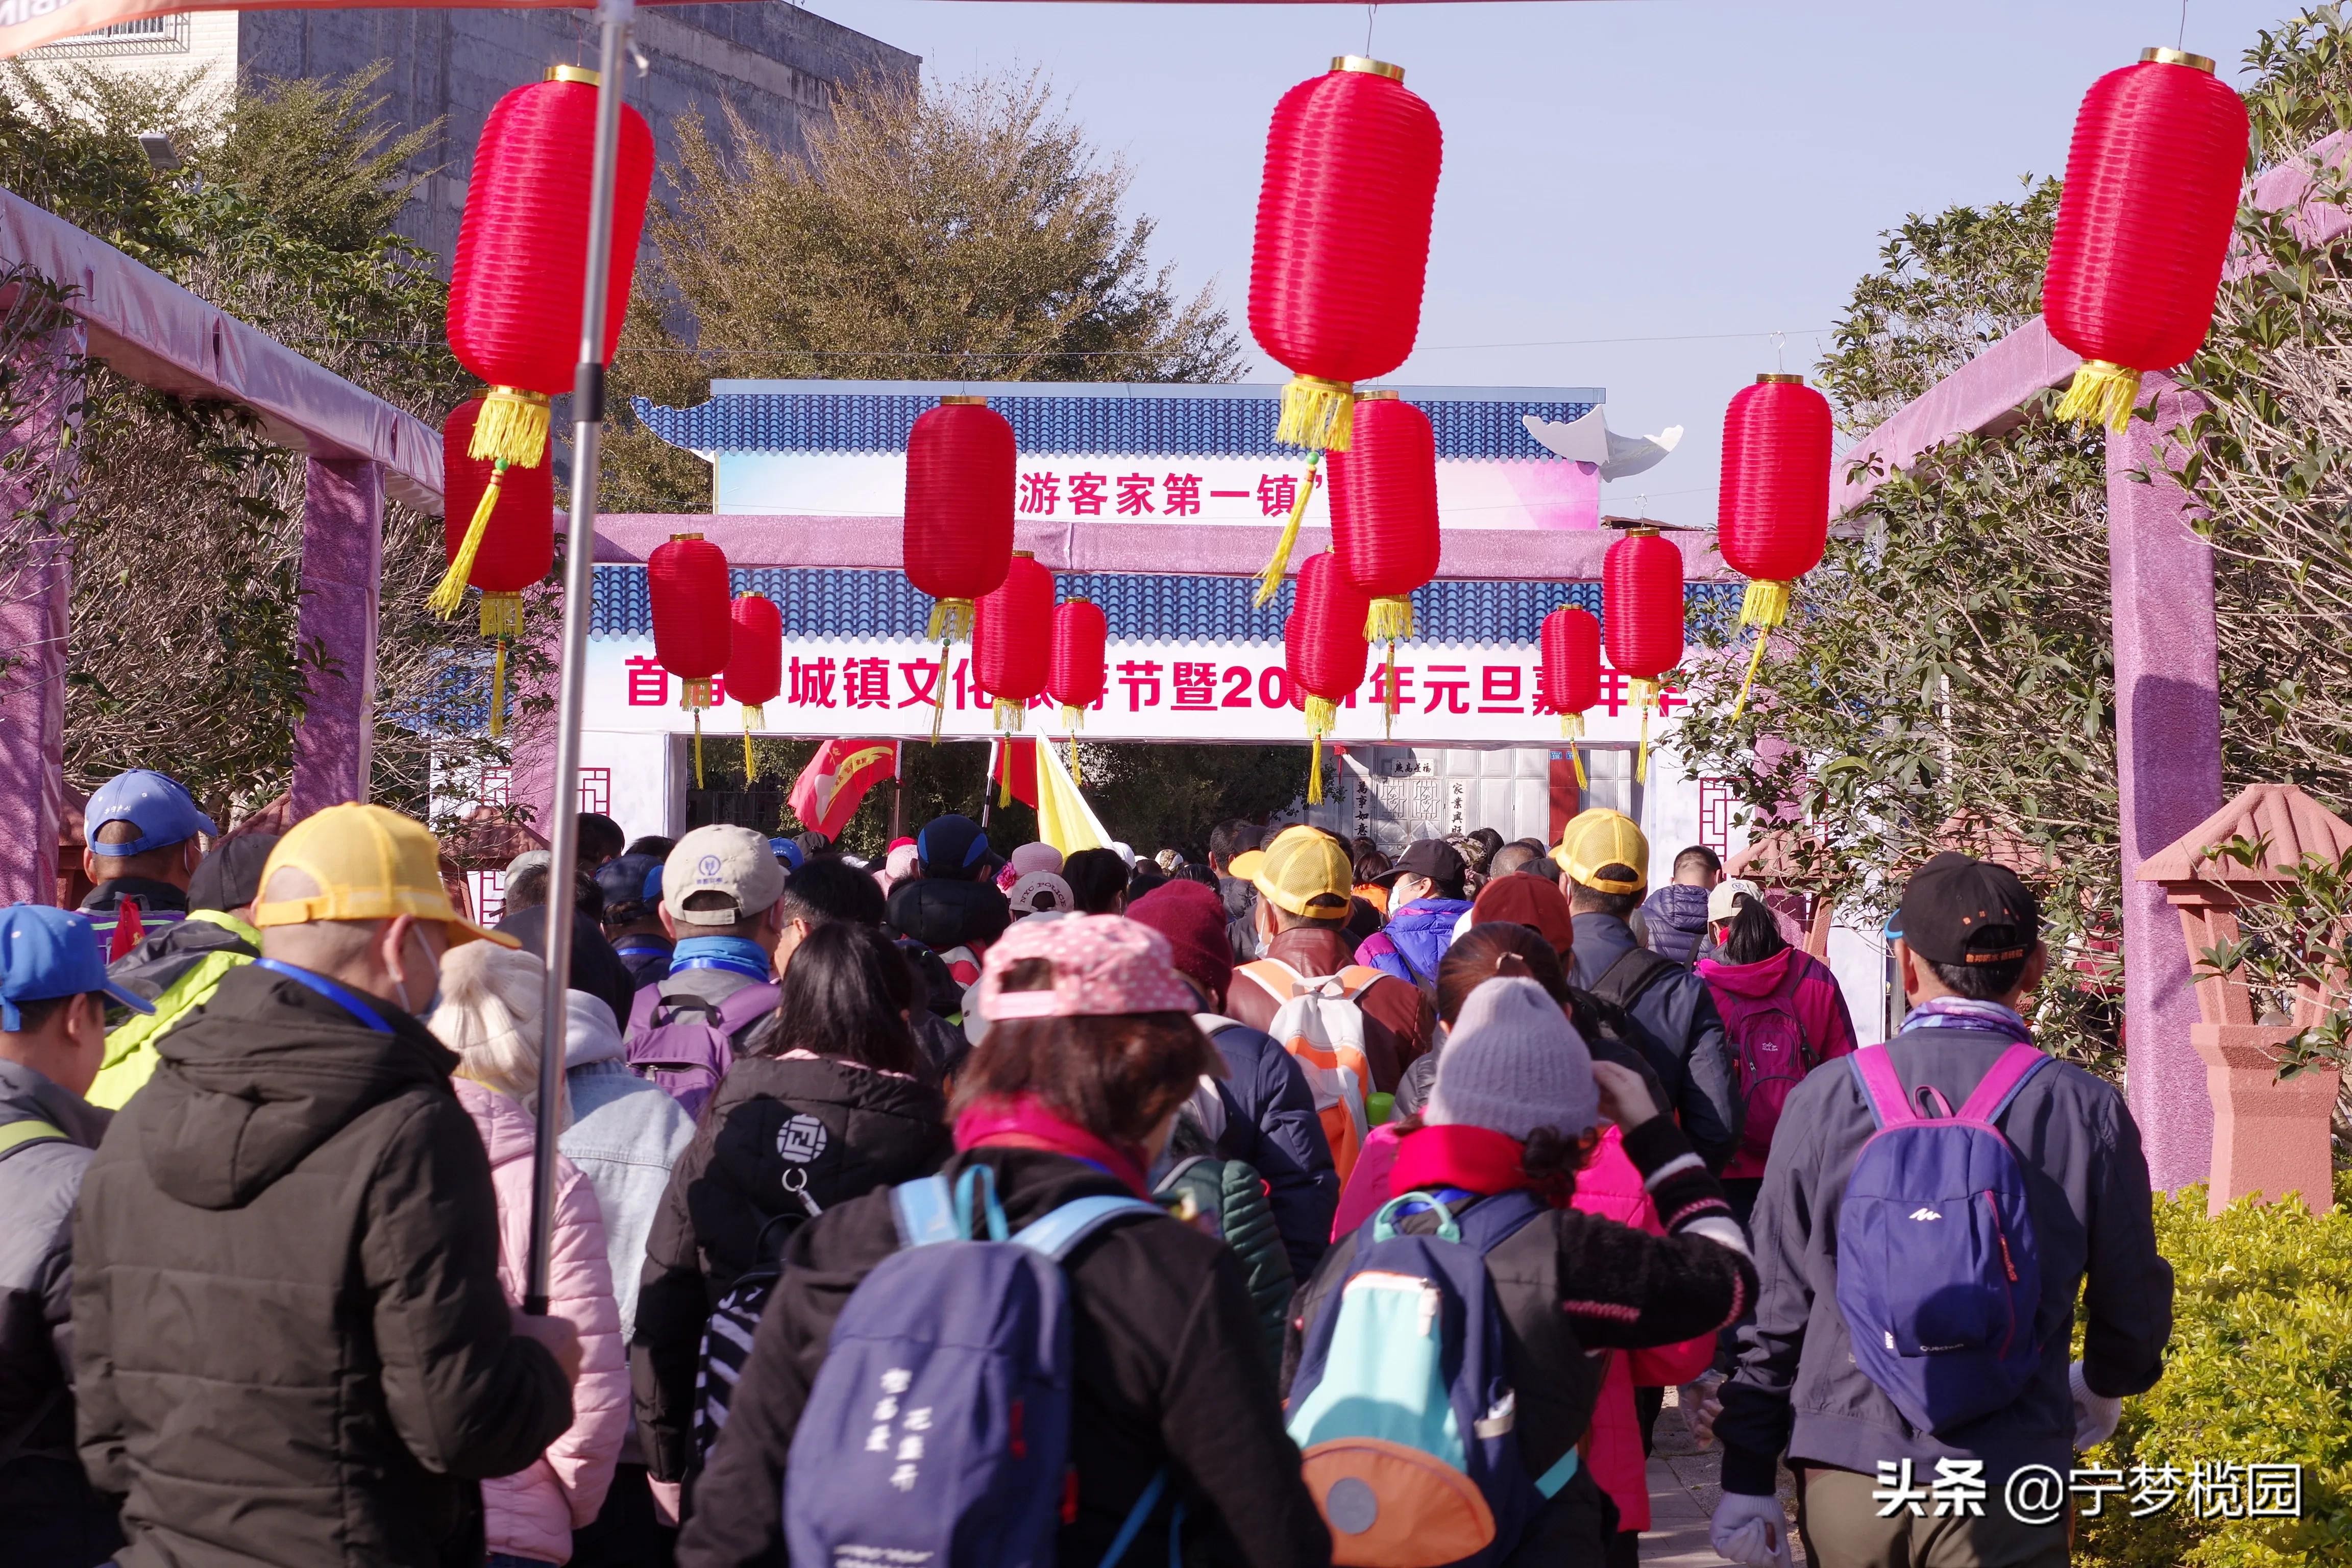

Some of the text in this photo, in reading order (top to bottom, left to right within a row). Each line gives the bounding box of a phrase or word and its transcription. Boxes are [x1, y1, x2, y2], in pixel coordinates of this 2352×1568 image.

[1020, 882, 1066, 907] NYC POLICE
[1919, 1343, 1964, 1352] Quechua
